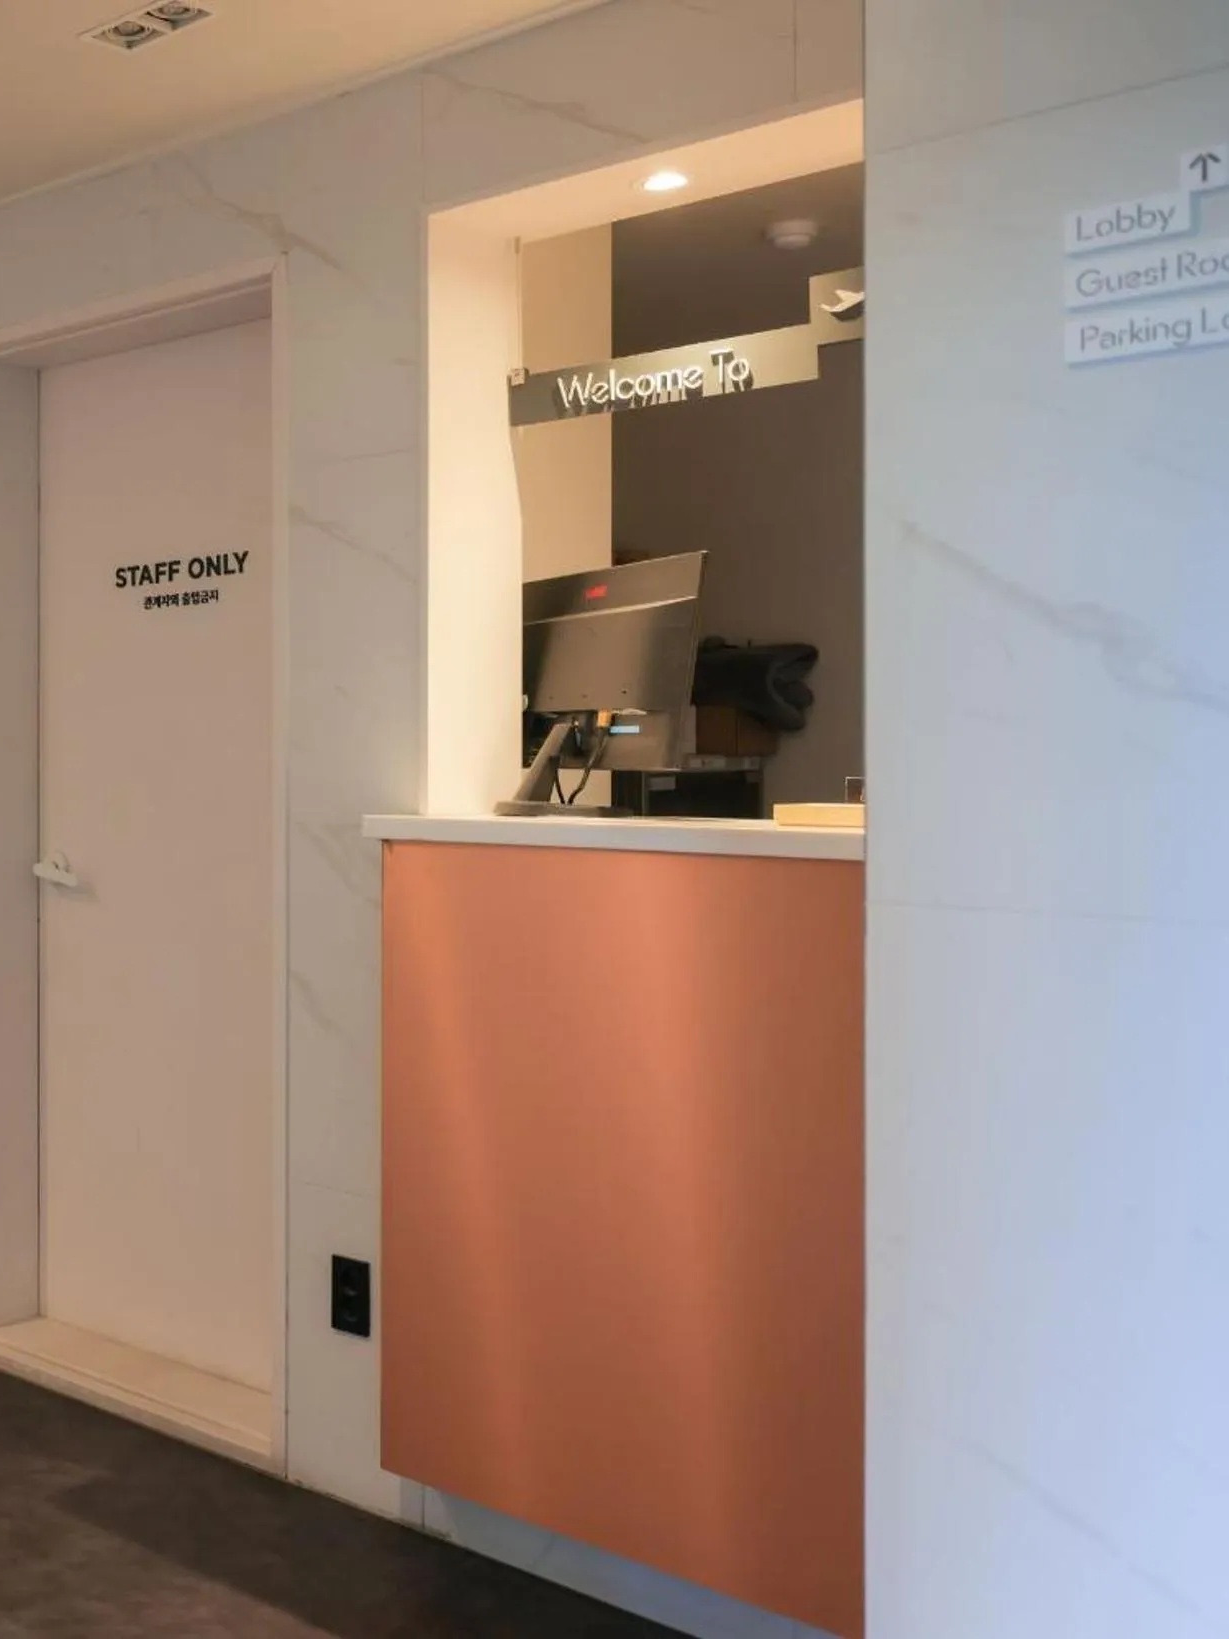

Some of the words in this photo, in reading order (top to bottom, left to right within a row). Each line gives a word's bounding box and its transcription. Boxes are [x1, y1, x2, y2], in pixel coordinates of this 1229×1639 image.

[1076, 203, 1176, 242] Lobby
[1075, 256, 1169, 297] Guest
[1080, 314, 1193, 353] Parking
[556, 362, 703, 408] Welcome
[710, 348, 750, 384] To
[115, 560, 181, 588] STAFF
[188, 551, 249, 579] ONLY
